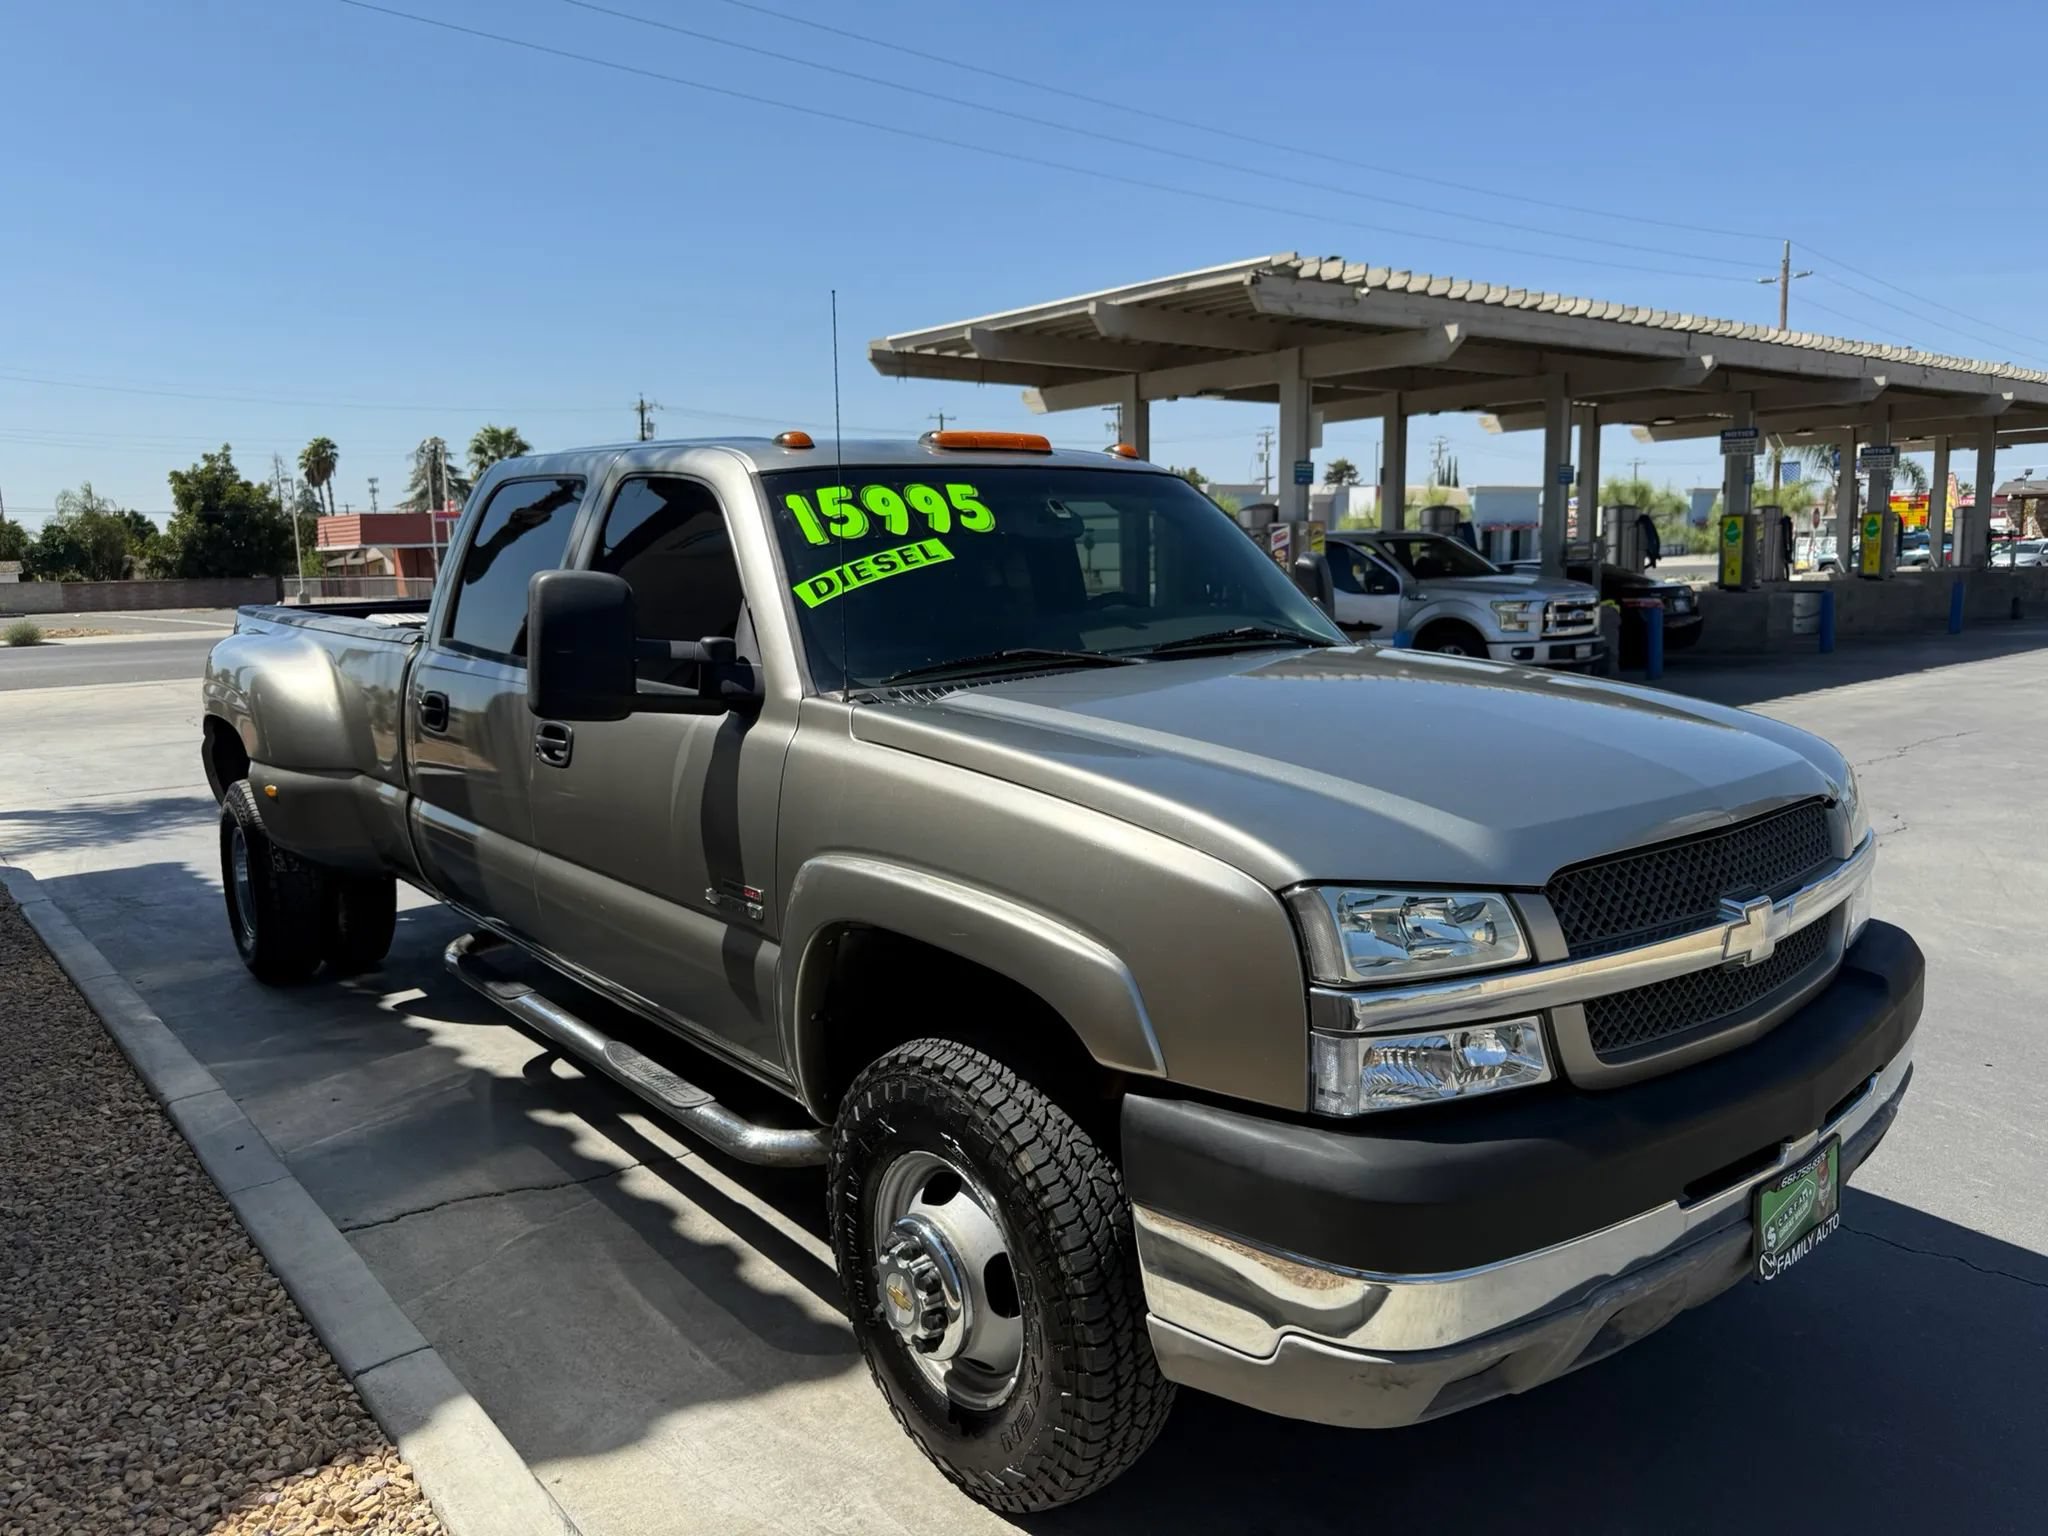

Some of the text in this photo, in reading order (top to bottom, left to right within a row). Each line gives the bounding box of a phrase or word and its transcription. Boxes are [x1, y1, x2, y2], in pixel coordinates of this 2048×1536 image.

[785, 483, 996, 545] 15995
[808, 543, 942, 599] DIESEL
[1777, 1232, 1814, 1275] FAMILY
[1815, 1212, 1840, 1246] AUTO
